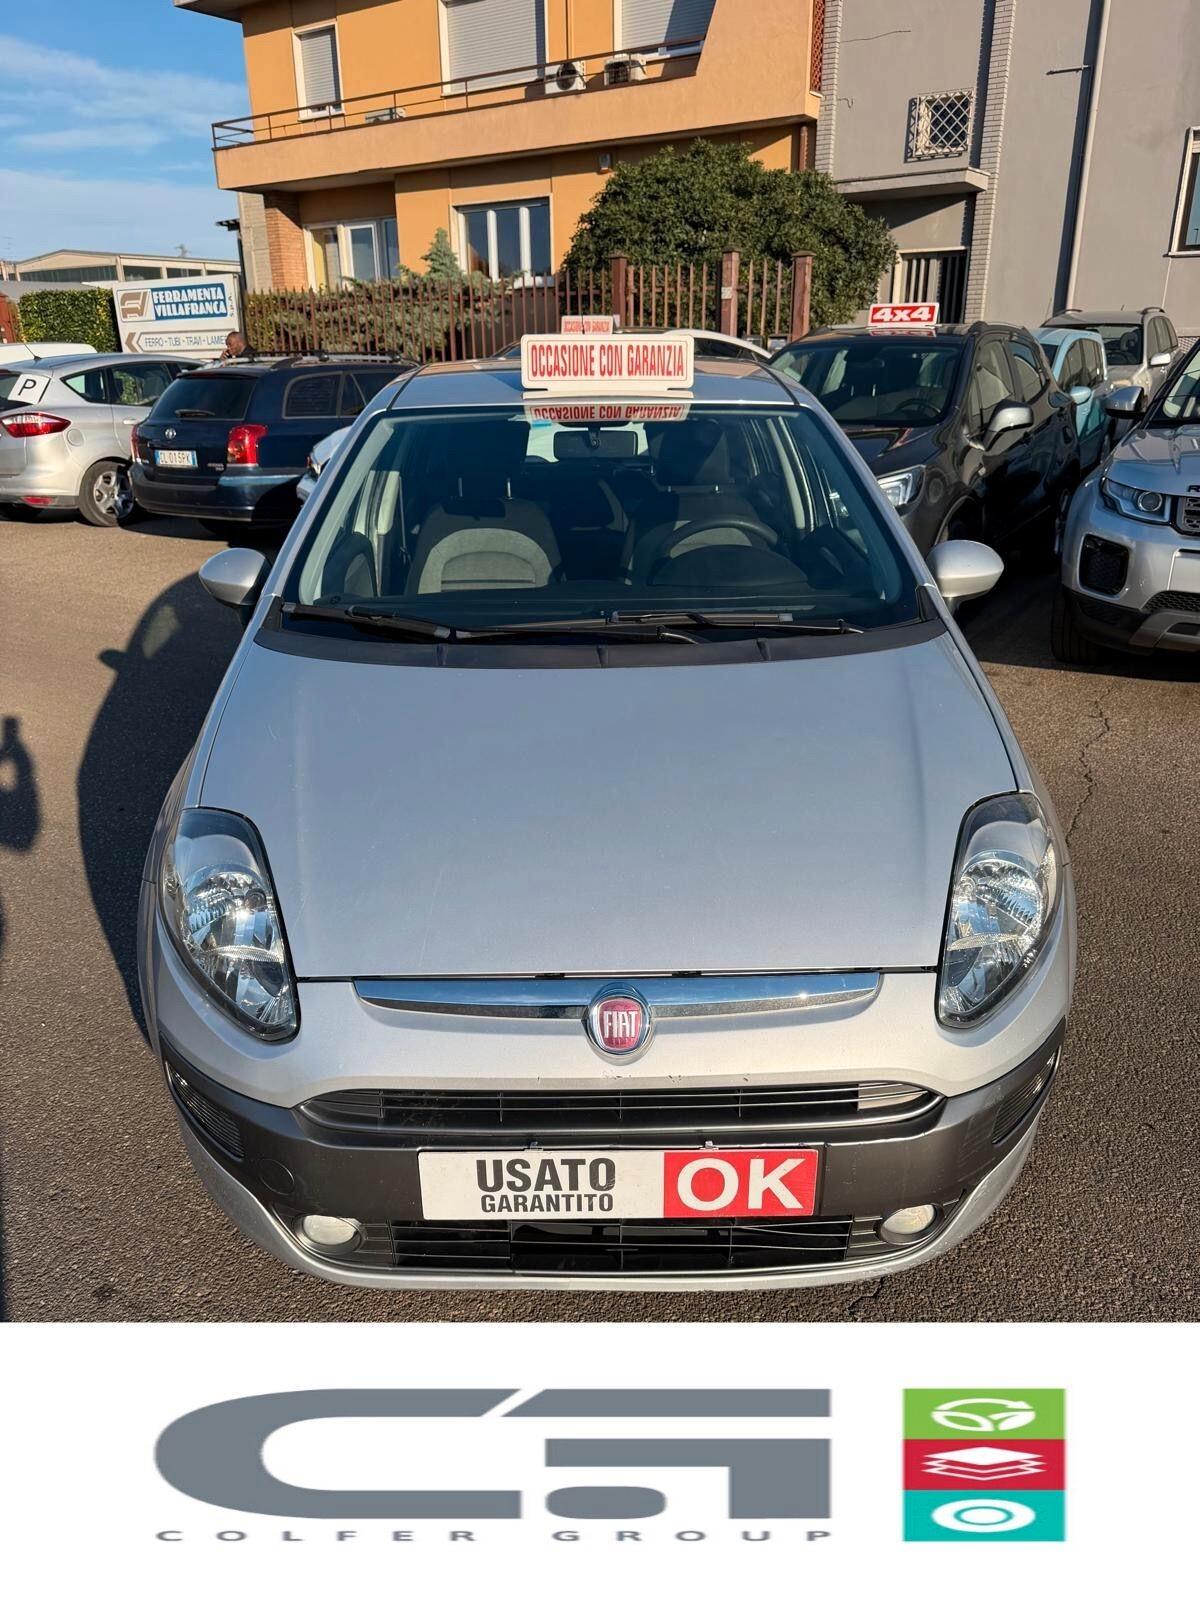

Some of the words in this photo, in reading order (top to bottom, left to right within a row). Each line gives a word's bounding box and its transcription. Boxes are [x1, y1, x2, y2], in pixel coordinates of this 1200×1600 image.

[152, 287, 224, 304] FERRAMENTA
[154, 300, 226, 317] VILLAFRANCA
[873, 307, 931, 322] 4x4
[531, 344, 595, 378] OCCASIONE
[599, 344, 623, 378] CON
[627, 344, 684, 377] GARANZIA
[18, 379, 37, 396] P
[603, 1010, 639, 1039] FIAT
[476, 1158, 616, 1192] USATO
[677, 1158, 804, 1211] OK
[481, 1193, 614, 1213] GARANTITO
